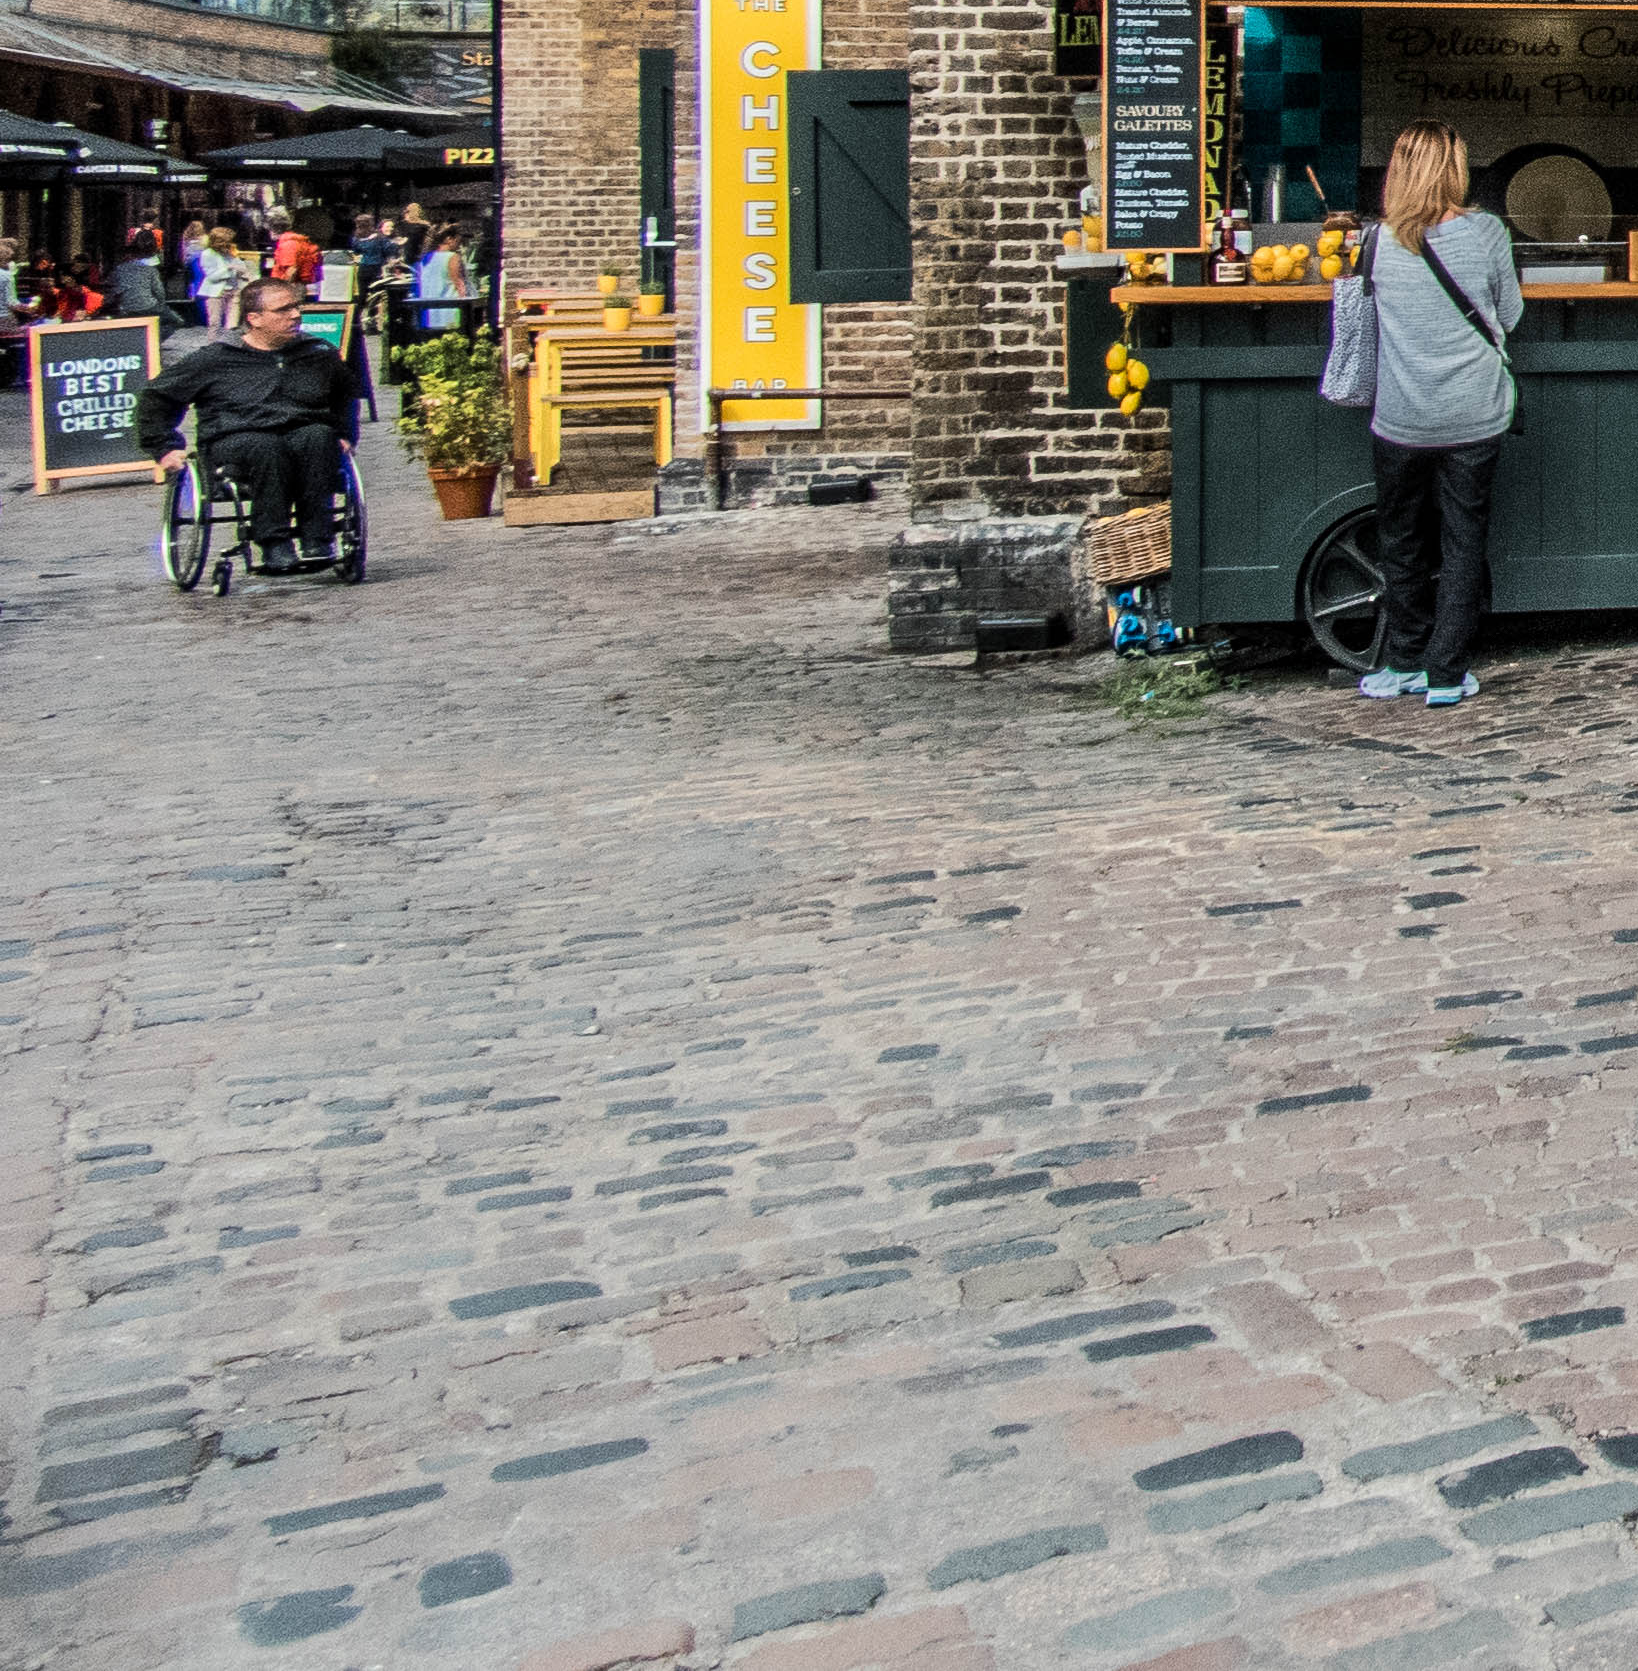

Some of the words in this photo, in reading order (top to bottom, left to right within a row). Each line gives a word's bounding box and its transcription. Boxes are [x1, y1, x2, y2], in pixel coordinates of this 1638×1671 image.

[1386, 26, 1562, 58] Delicious
[1394, 70, 1531, 112] Freshly
[1116, 105, 1185, 117] SAVOURY
[1114, 120, 1193, 131] GALETTES
[741, 41, 782, 343] CHEESE
[64, 372, 126, 396] BEST
[61, 411, 134, 433] CHEESE
